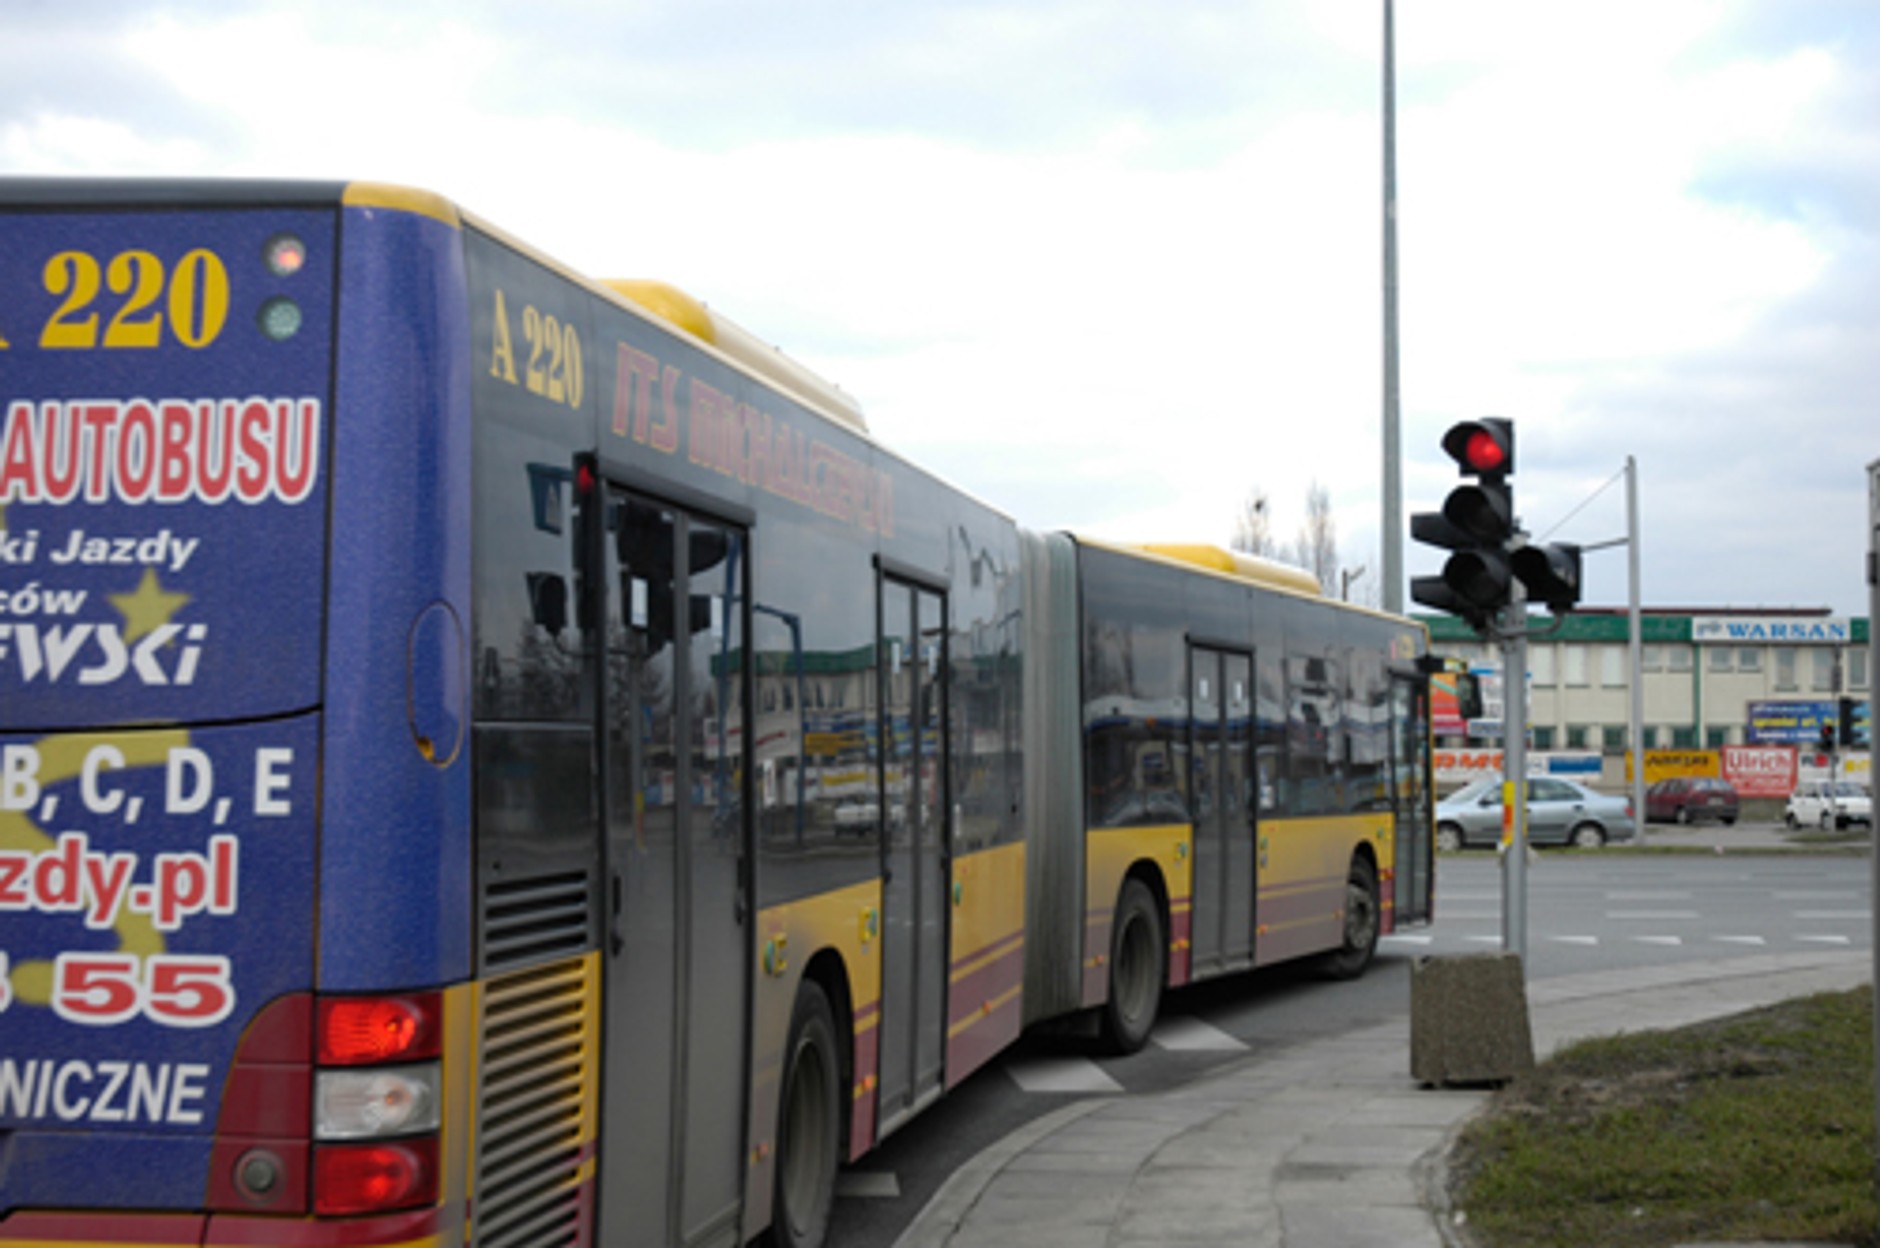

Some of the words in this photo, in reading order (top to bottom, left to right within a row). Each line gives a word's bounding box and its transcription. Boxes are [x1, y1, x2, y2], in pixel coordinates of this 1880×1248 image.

[39, 248, 230, 349] 220
[490, 289, 518, 385] A
[522, 305, 583, 410] 220
[0, 398, 320, 504] AUTOBUSU
[50, 529, 200, 572] Jazdy
[80, 745, 143, 824] C,
[165, 748, 232, 825] D,
[254, 748, 293, 815] E
[52, 953, 235, 1027] 55
